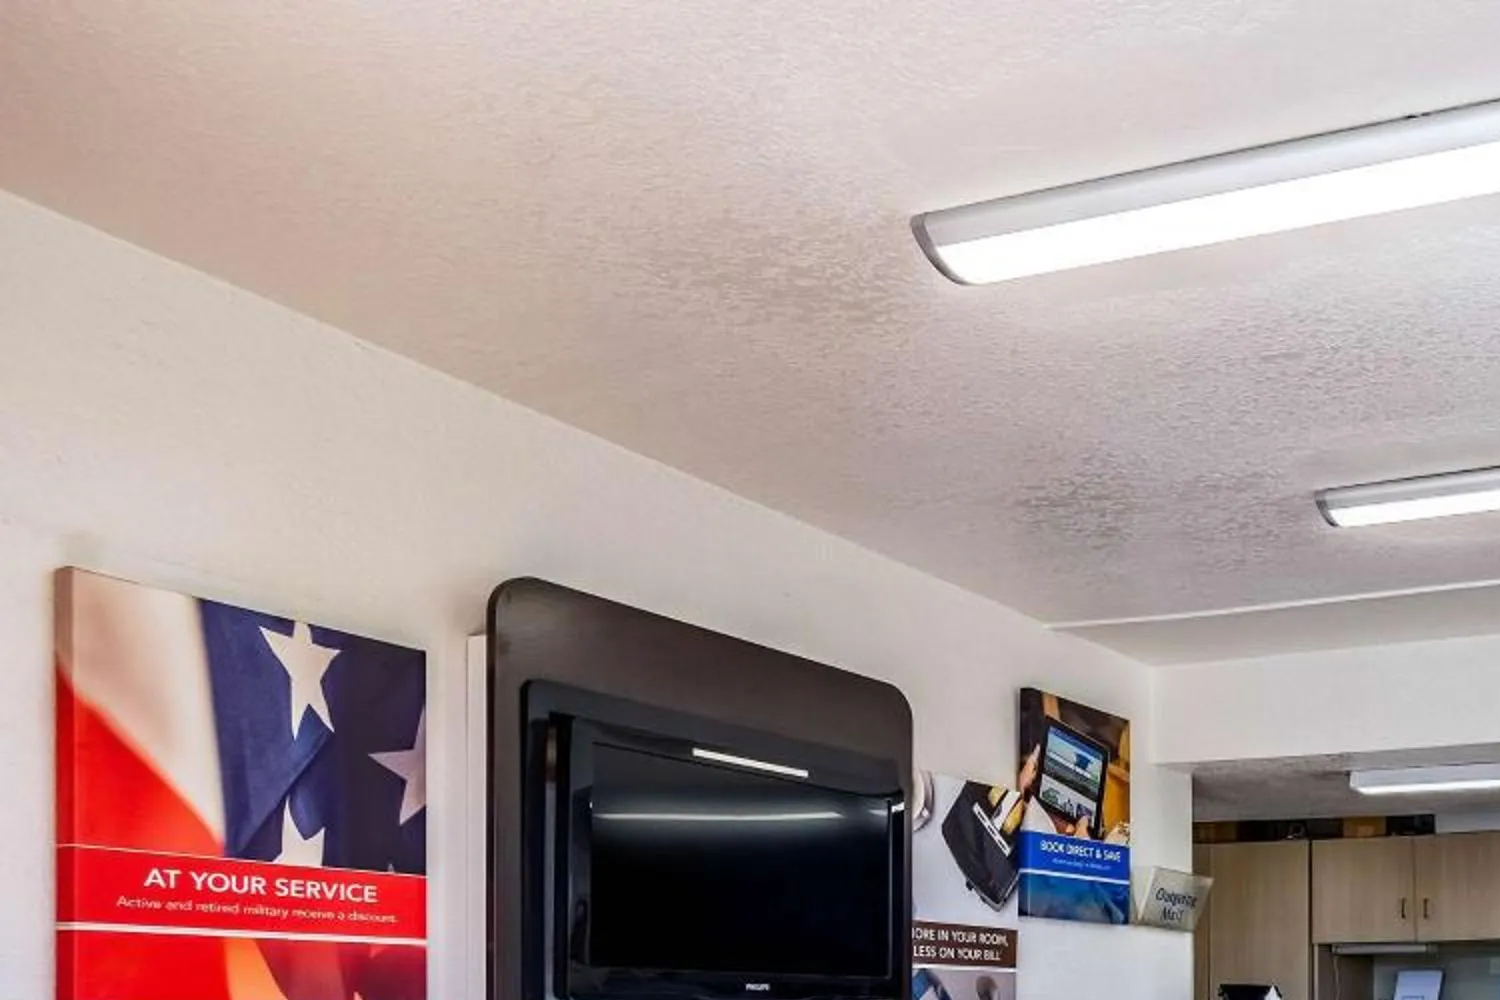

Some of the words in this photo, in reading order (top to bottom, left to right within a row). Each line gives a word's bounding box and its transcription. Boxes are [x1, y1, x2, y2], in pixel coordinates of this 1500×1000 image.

[1040, 840, 1065, 853] BOOK
[1066, 844, 1094, 858] DIRECT
[143, 867, 181, 889] AT
[190, 871, 267, 895] YOUR
[274, 877, 378, 903] SERVICE
[116, 895, 161, 909] Active
[165, 900, 192, 911] and
[195, 901, 239, 915] retired
[243, 904, 288, 919] military
[937, 929, 949, 941] IN
[951, 931, 976, 943] YOUR
[913, 945, 936, 958] LESS
[939, 947, 955, 959] ON
[957, 948, 982, 960] YOUR
